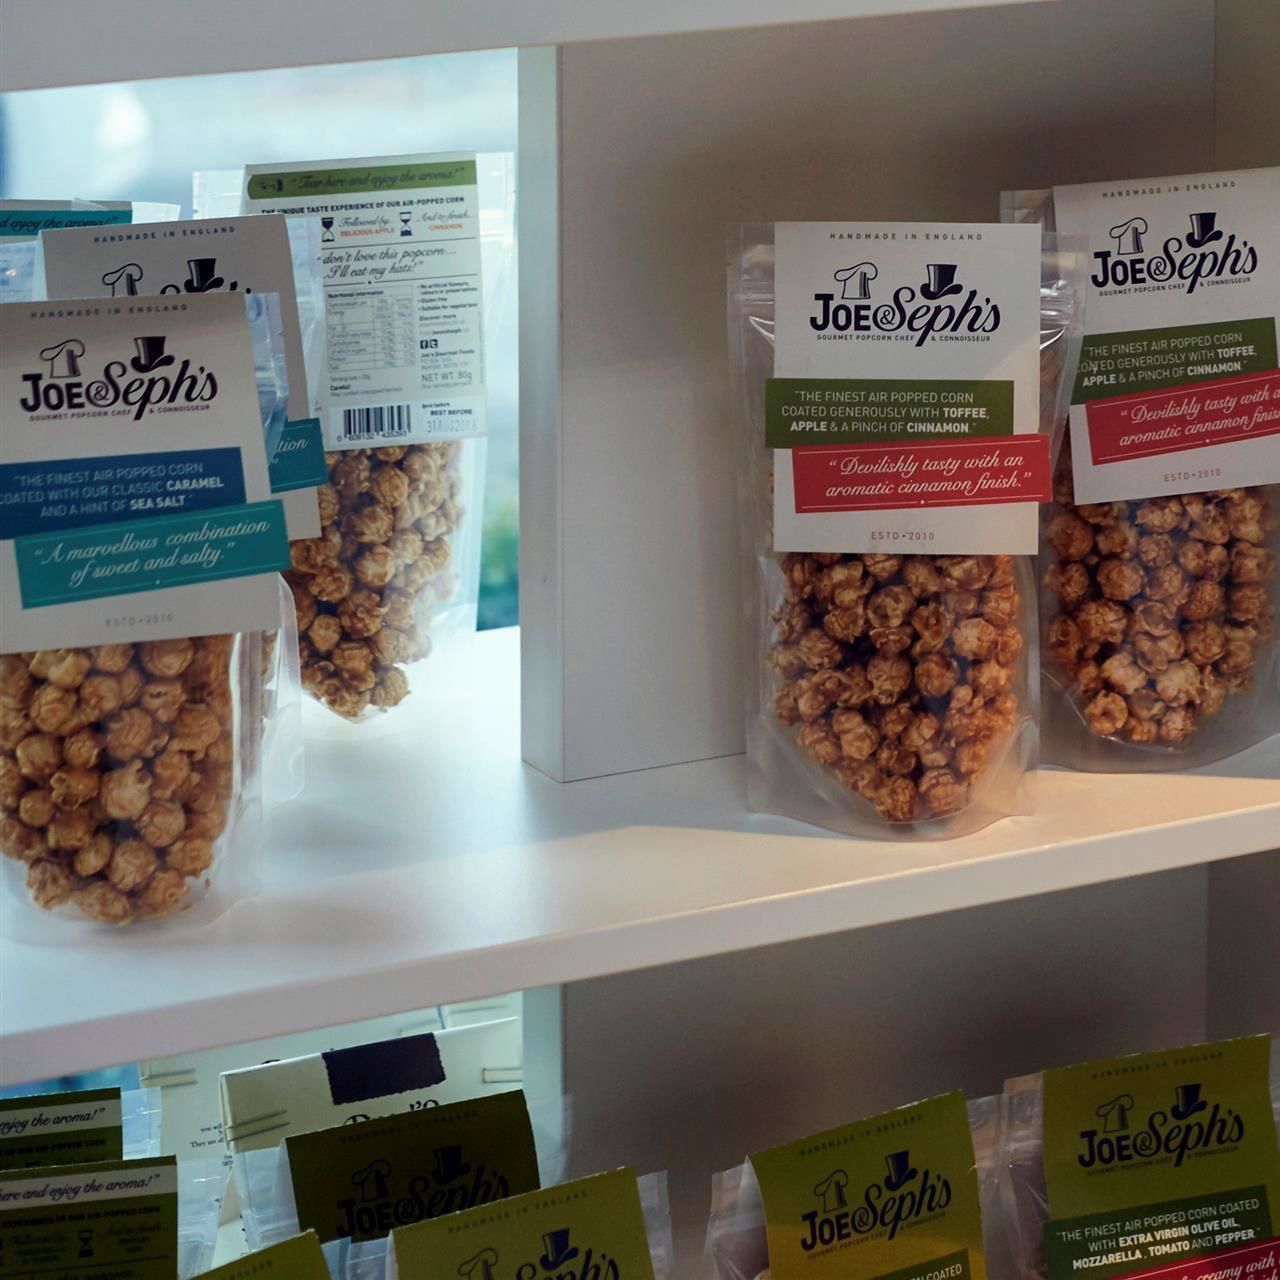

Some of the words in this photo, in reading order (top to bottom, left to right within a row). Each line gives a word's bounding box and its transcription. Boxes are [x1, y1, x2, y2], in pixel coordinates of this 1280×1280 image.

[401, 167, 416, 181] the
[1103, 187, 1161, 198] HANDMADE
[1186, 181, 1236, 191] ENGLAND
[331, 202, 374, 212] EXPERIENCE
[402, 197, 443, 206] AIR-POPPED
[354, 251, 377, 262] love
[379, 248, 398, 260] this
[350, 266, 366, 277] eat
[369, 265, 387, 279] my
[1112, 343, 1147, 355] FINEST
[1151, 340, 1168, 351] AIR
[1170, 336, 1211, 349] POPPED
[1214, 333, 1242, 344] CORN
[1117, 354, 1186, 369] GENEROUSLY
[1188, 349, 1214, 361] WITH
[1217, 345, 1257, 359] TOFFEE,
[422, 373, 438, 382] NET
[1082, 374, 1116, 387] APPLE
[1119, 373, 1126, 383] &
[1129, 372, 1136, 382] A
[1138, 369, 1170, 381] PINCH
[1172, 367, 1185, 378] OF
[825, 391, 865, 402] FINEST
[869, 392, 888, 402] AIR
[891, 392, 938, 403] POPPED
[940, 392, 973, 403] CORN
[1204, 393, 1237, 413] tasty
[1240, 384, 1269, 404] with
[781, 406, 827, 417] COATED
[830, 407, 907, 418] GENEROUSLY
[909, 407, 939, 418] WITH
[943, 408, 989, 419] TOFFEE,
[790, 421, 827, 432] APPLE
[830, 421, 838, 432] &
[841, 422, 849, 432] A
[851, 422, 887, 432] PINCH
[890, 422, 904, 432] OF
[1120, 425, 1181, 447] aromatic
[1184, 417, 1249, 436] cinnamon
[922, 454, 959, 476] tasty
[964, 450, 1000, 468] with
[1003, 456, 1024, 467] an
[47, 471, 90, 486] FINEST
[93, 468, 114, 481] AIR
[117, 465, 166, 480] POPPED
[168, 463, 203, 476] CORN
[47, 487, 80, 501] WITH
[82, 485, 109, 499] OUR
[112, 481, 163, 496] CLASSIC
[166, 476, 224, 490] CARAMEL
[826, 482, 894, 497] aromatic
[897, 479, 971, 494] cinnamon
[40, 504, 67, 518] AND
[69, 503, 78, 515] A
[80, 501, 109, 514] HINT
[113, 499, 128, 512] OF
[129, 497, 154, 510] SEA
[67, 532, 158, 561] marvellous
[166, 519, 270, 545] combination
[69, 563, 91, 589] of
[92, 557, 141, 578] sweet
[144, 550, 179, 569] and
[32, 1113, 50, 1127] the
[23, 1184, 48, 1198] and
[50, 1186, 81, 1201] enjoy
[83, 1179, 103, 1193] the
[1085, 1222, 1121, 1237] FINEST
[1124, 1219, 1141, 1231] AIR
[1144, 1213, 1186, 1227] POPPED
[1188, 1207, 1217, 1220] CORN
[1219, 1198, 1259, 1215] COATED
[1088, 1239, 1116, 1252] WITH
[1119, 1233, 1154, 1247] EXTRA
[1155, 1226, 1190, 1241] VIRGIN
[1191, 1221, 1220, 1234] OLIVE
[1148, 1242, 1190, 1257] TOMATO
[1192, 1236, 1213, 1248] AND
[1245, 1250, 1275, 1273] with
